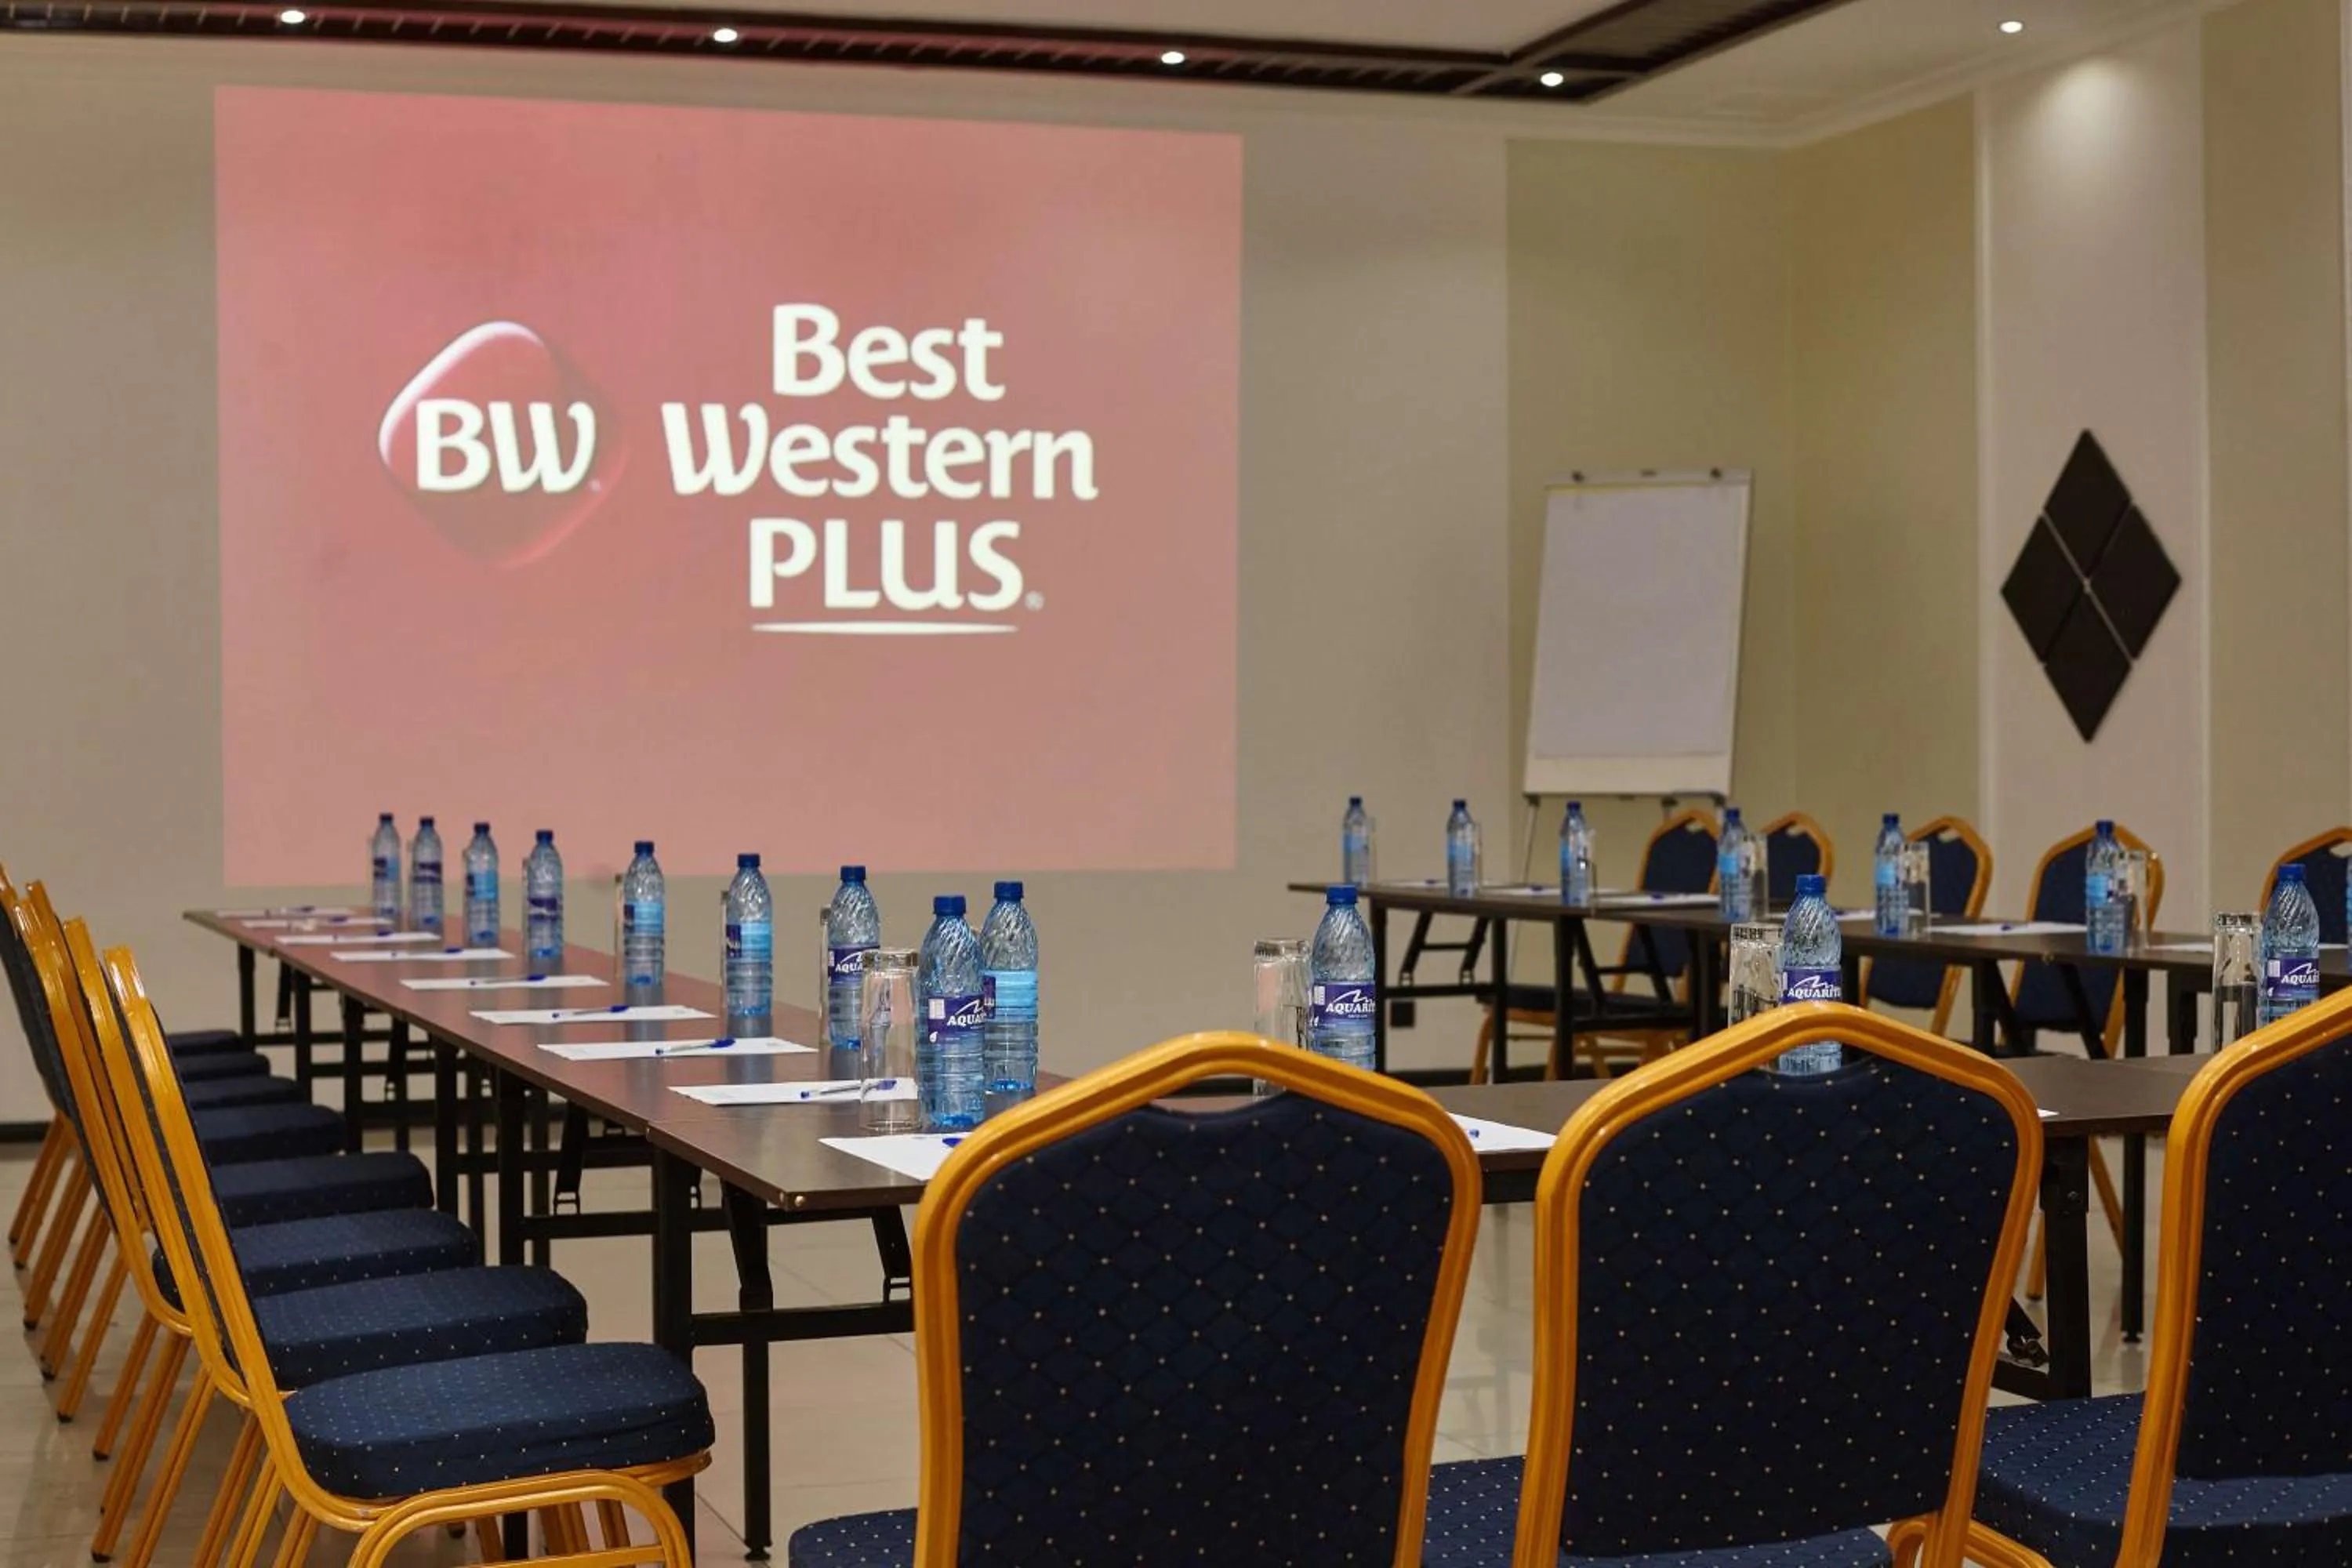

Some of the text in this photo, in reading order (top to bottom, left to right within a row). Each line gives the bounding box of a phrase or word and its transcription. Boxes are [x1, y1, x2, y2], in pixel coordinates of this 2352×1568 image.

[773, 303, 1005, 401] Best
[416, 399, 595, 492] BW
[661, 402, 1098, 500] Western
[750, 517, 1023, 611] PLUS
